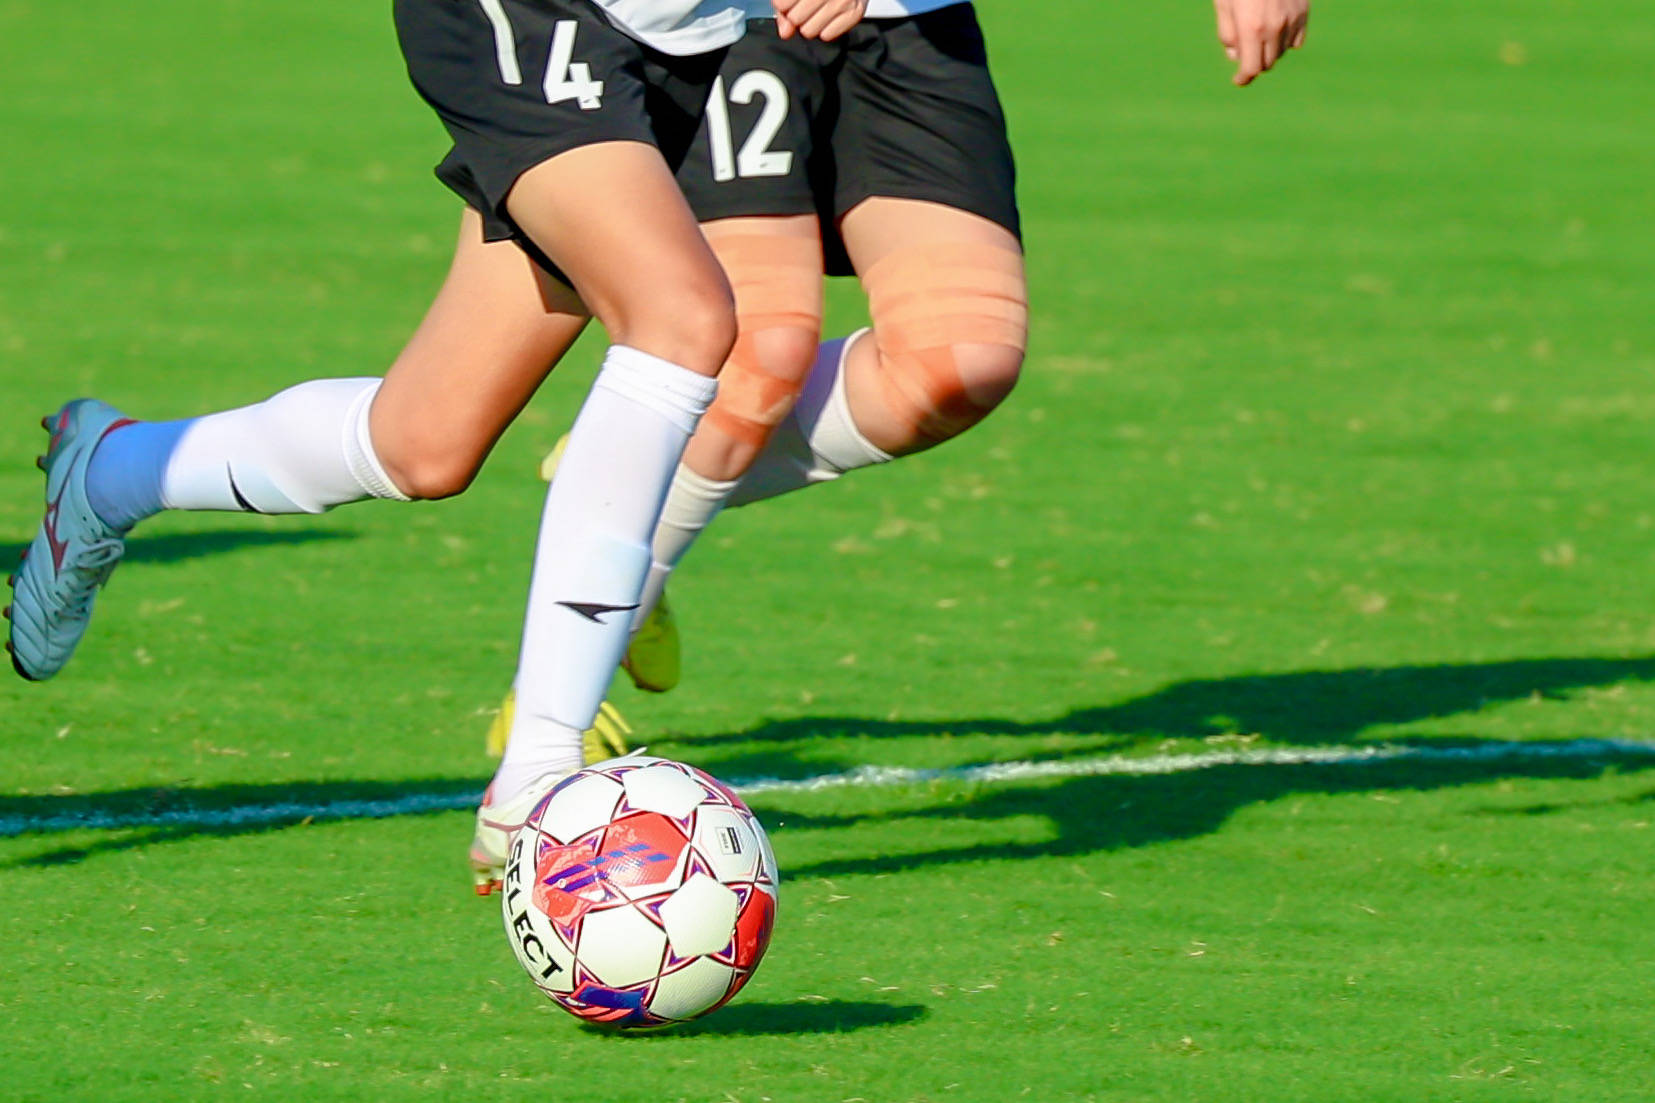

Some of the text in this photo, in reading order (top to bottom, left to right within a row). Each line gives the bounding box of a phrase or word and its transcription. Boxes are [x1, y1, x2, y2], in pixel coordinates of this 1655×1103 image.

[544, 19, 604, 110] 4
[705, 69, 794, 183] 12
[506, 838, 564, 979] SELECT
